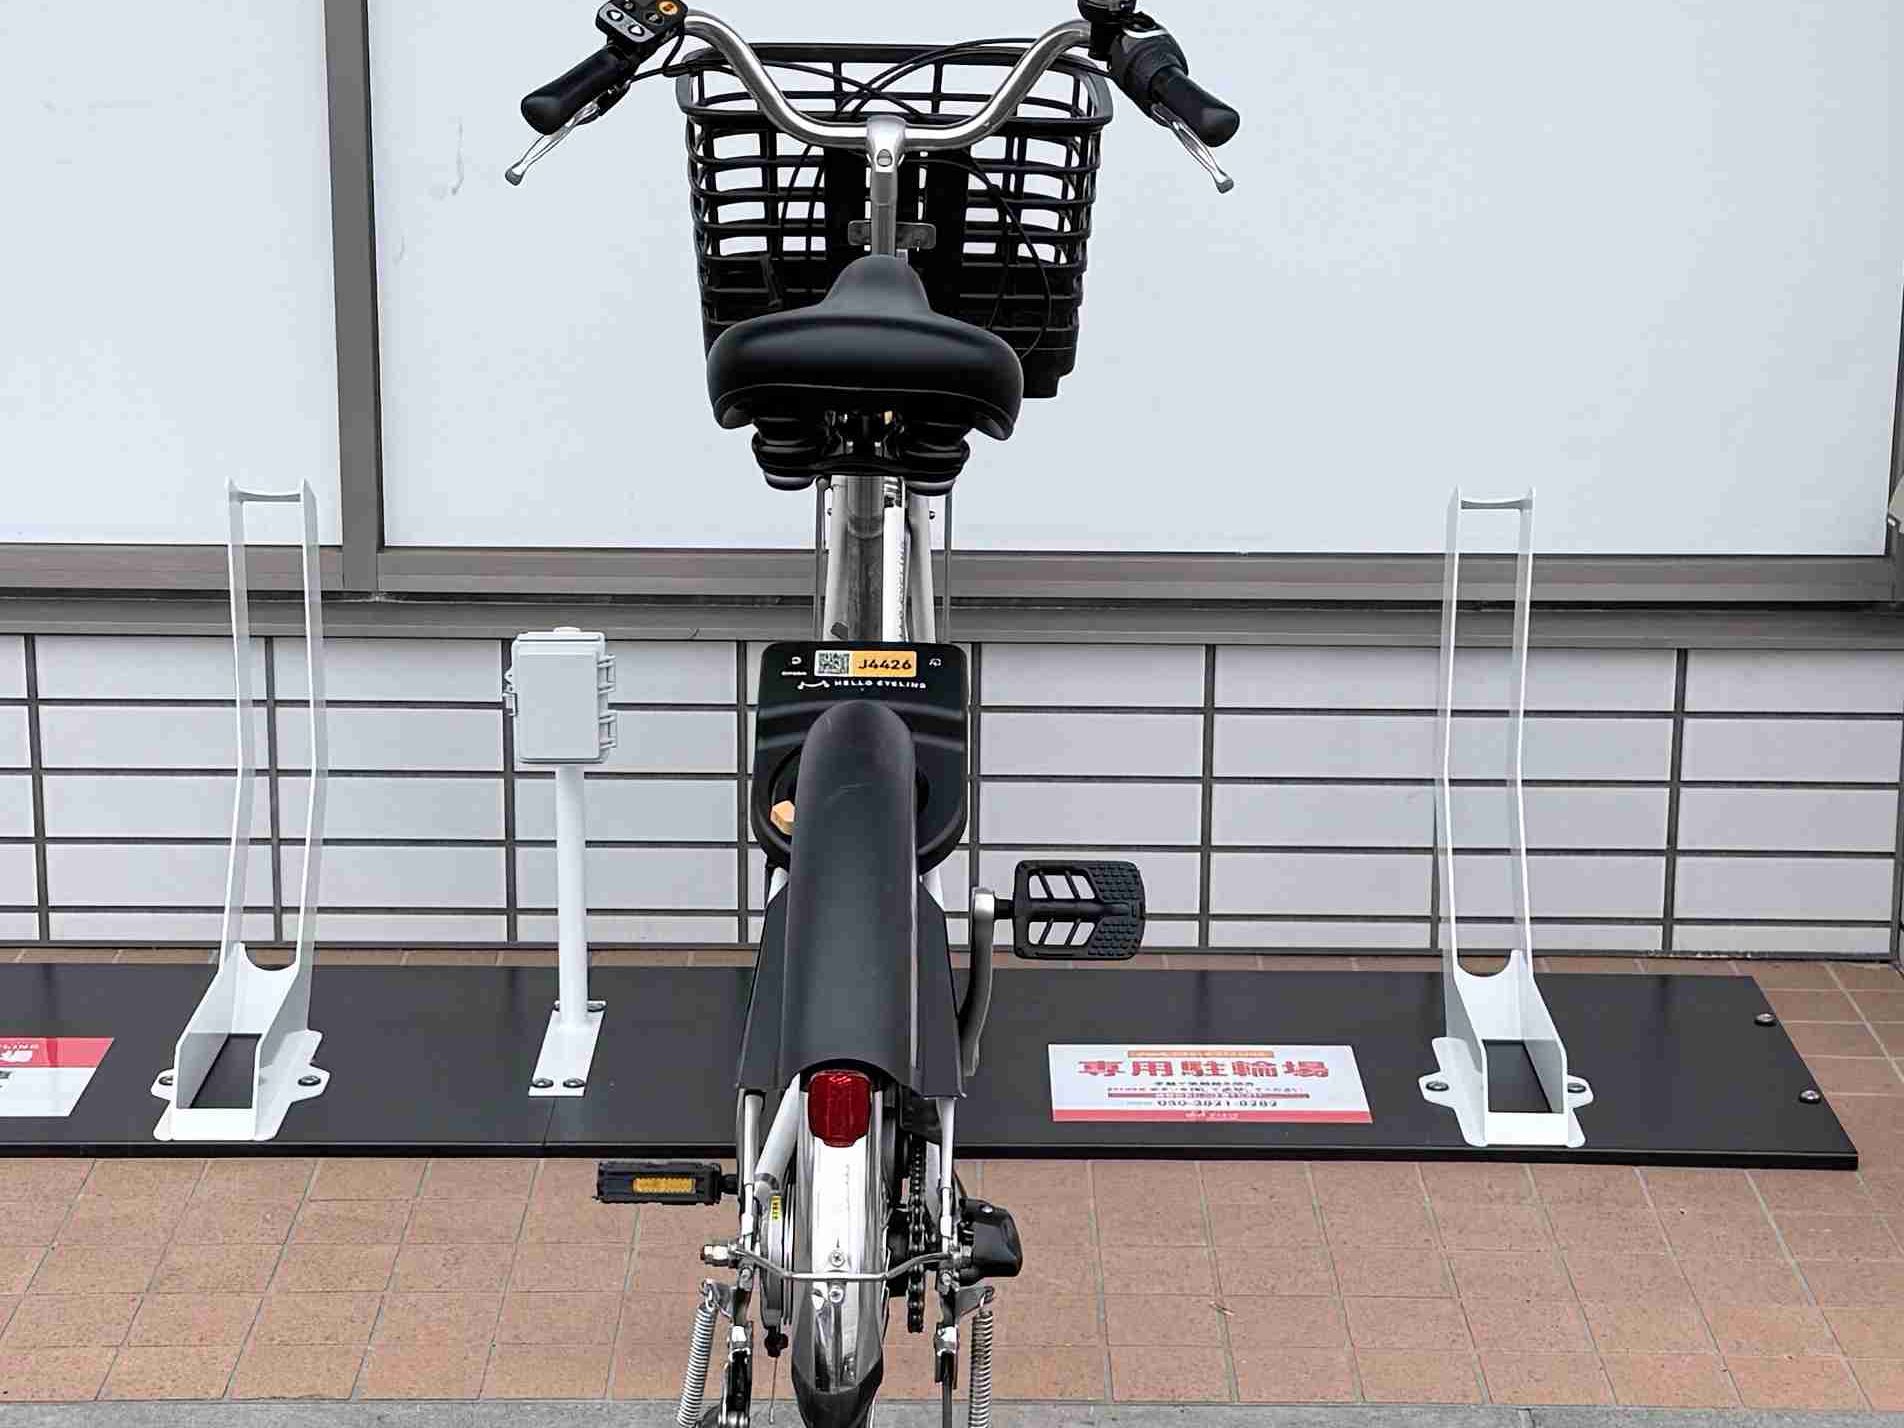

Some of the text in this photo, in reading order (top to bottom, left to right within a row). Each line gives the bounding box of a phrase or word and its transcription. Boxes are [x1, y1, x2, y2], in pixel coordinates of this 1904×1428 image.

[858, 658, 912, 671] J4426
[1078, 1059, 1330, 1079] 専用駐輪場
